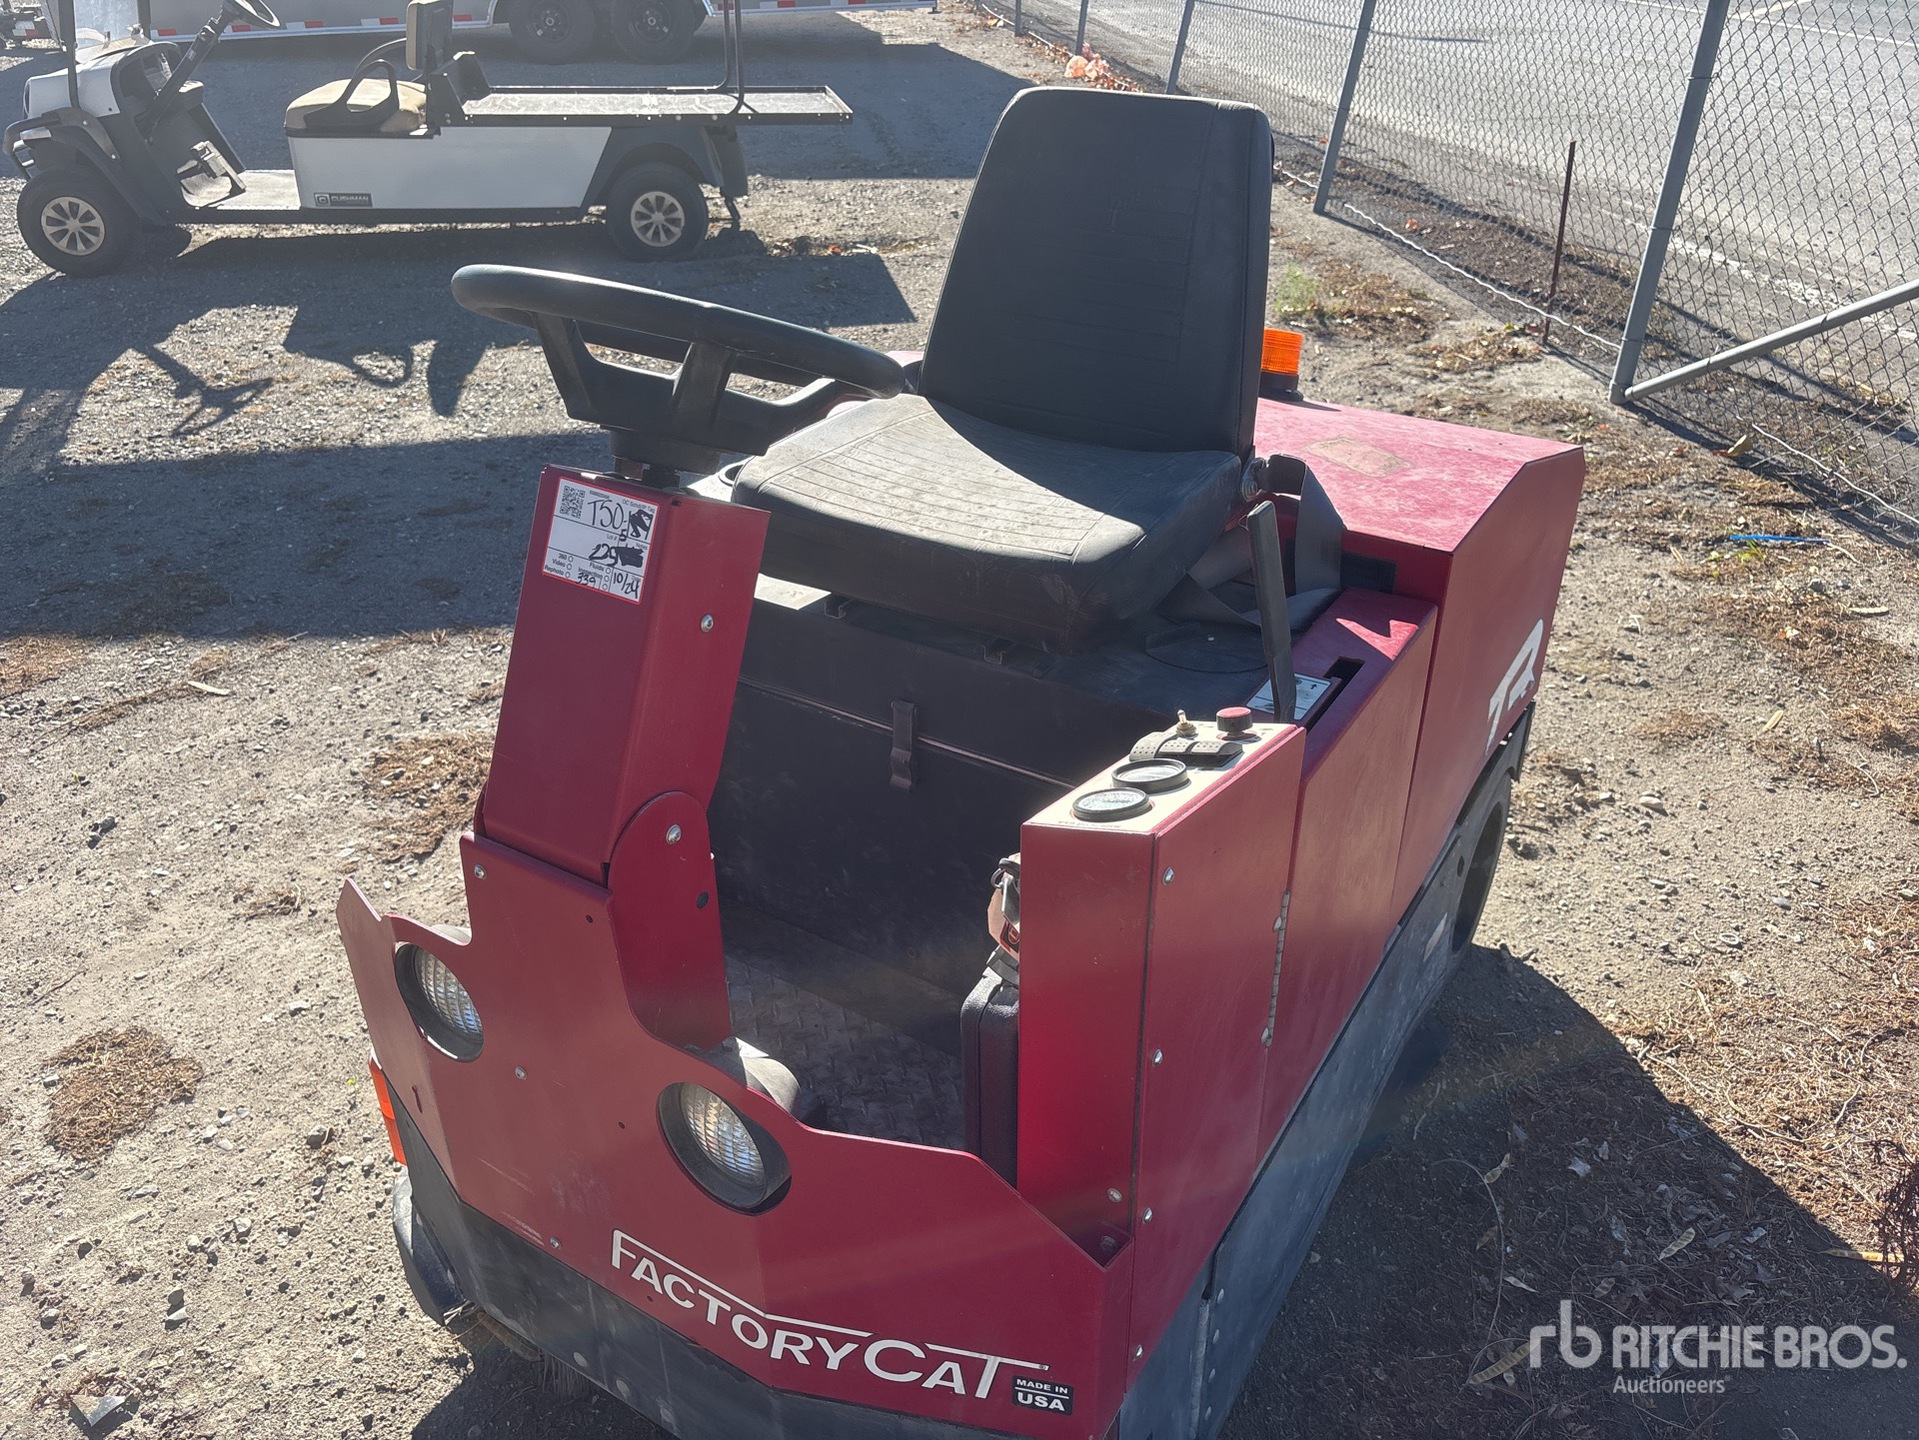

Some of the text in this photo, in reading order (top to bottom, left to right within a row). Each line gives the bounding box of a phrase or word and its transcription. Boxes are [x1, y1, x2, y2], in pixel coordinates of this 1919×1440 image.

[552, 558, 566, 569] Video
[589, 562, 605, 572] Fluids
[1016, 1378, 1068, 1394] MADE IN
[1017, 1391, 1065, 1412] USA
